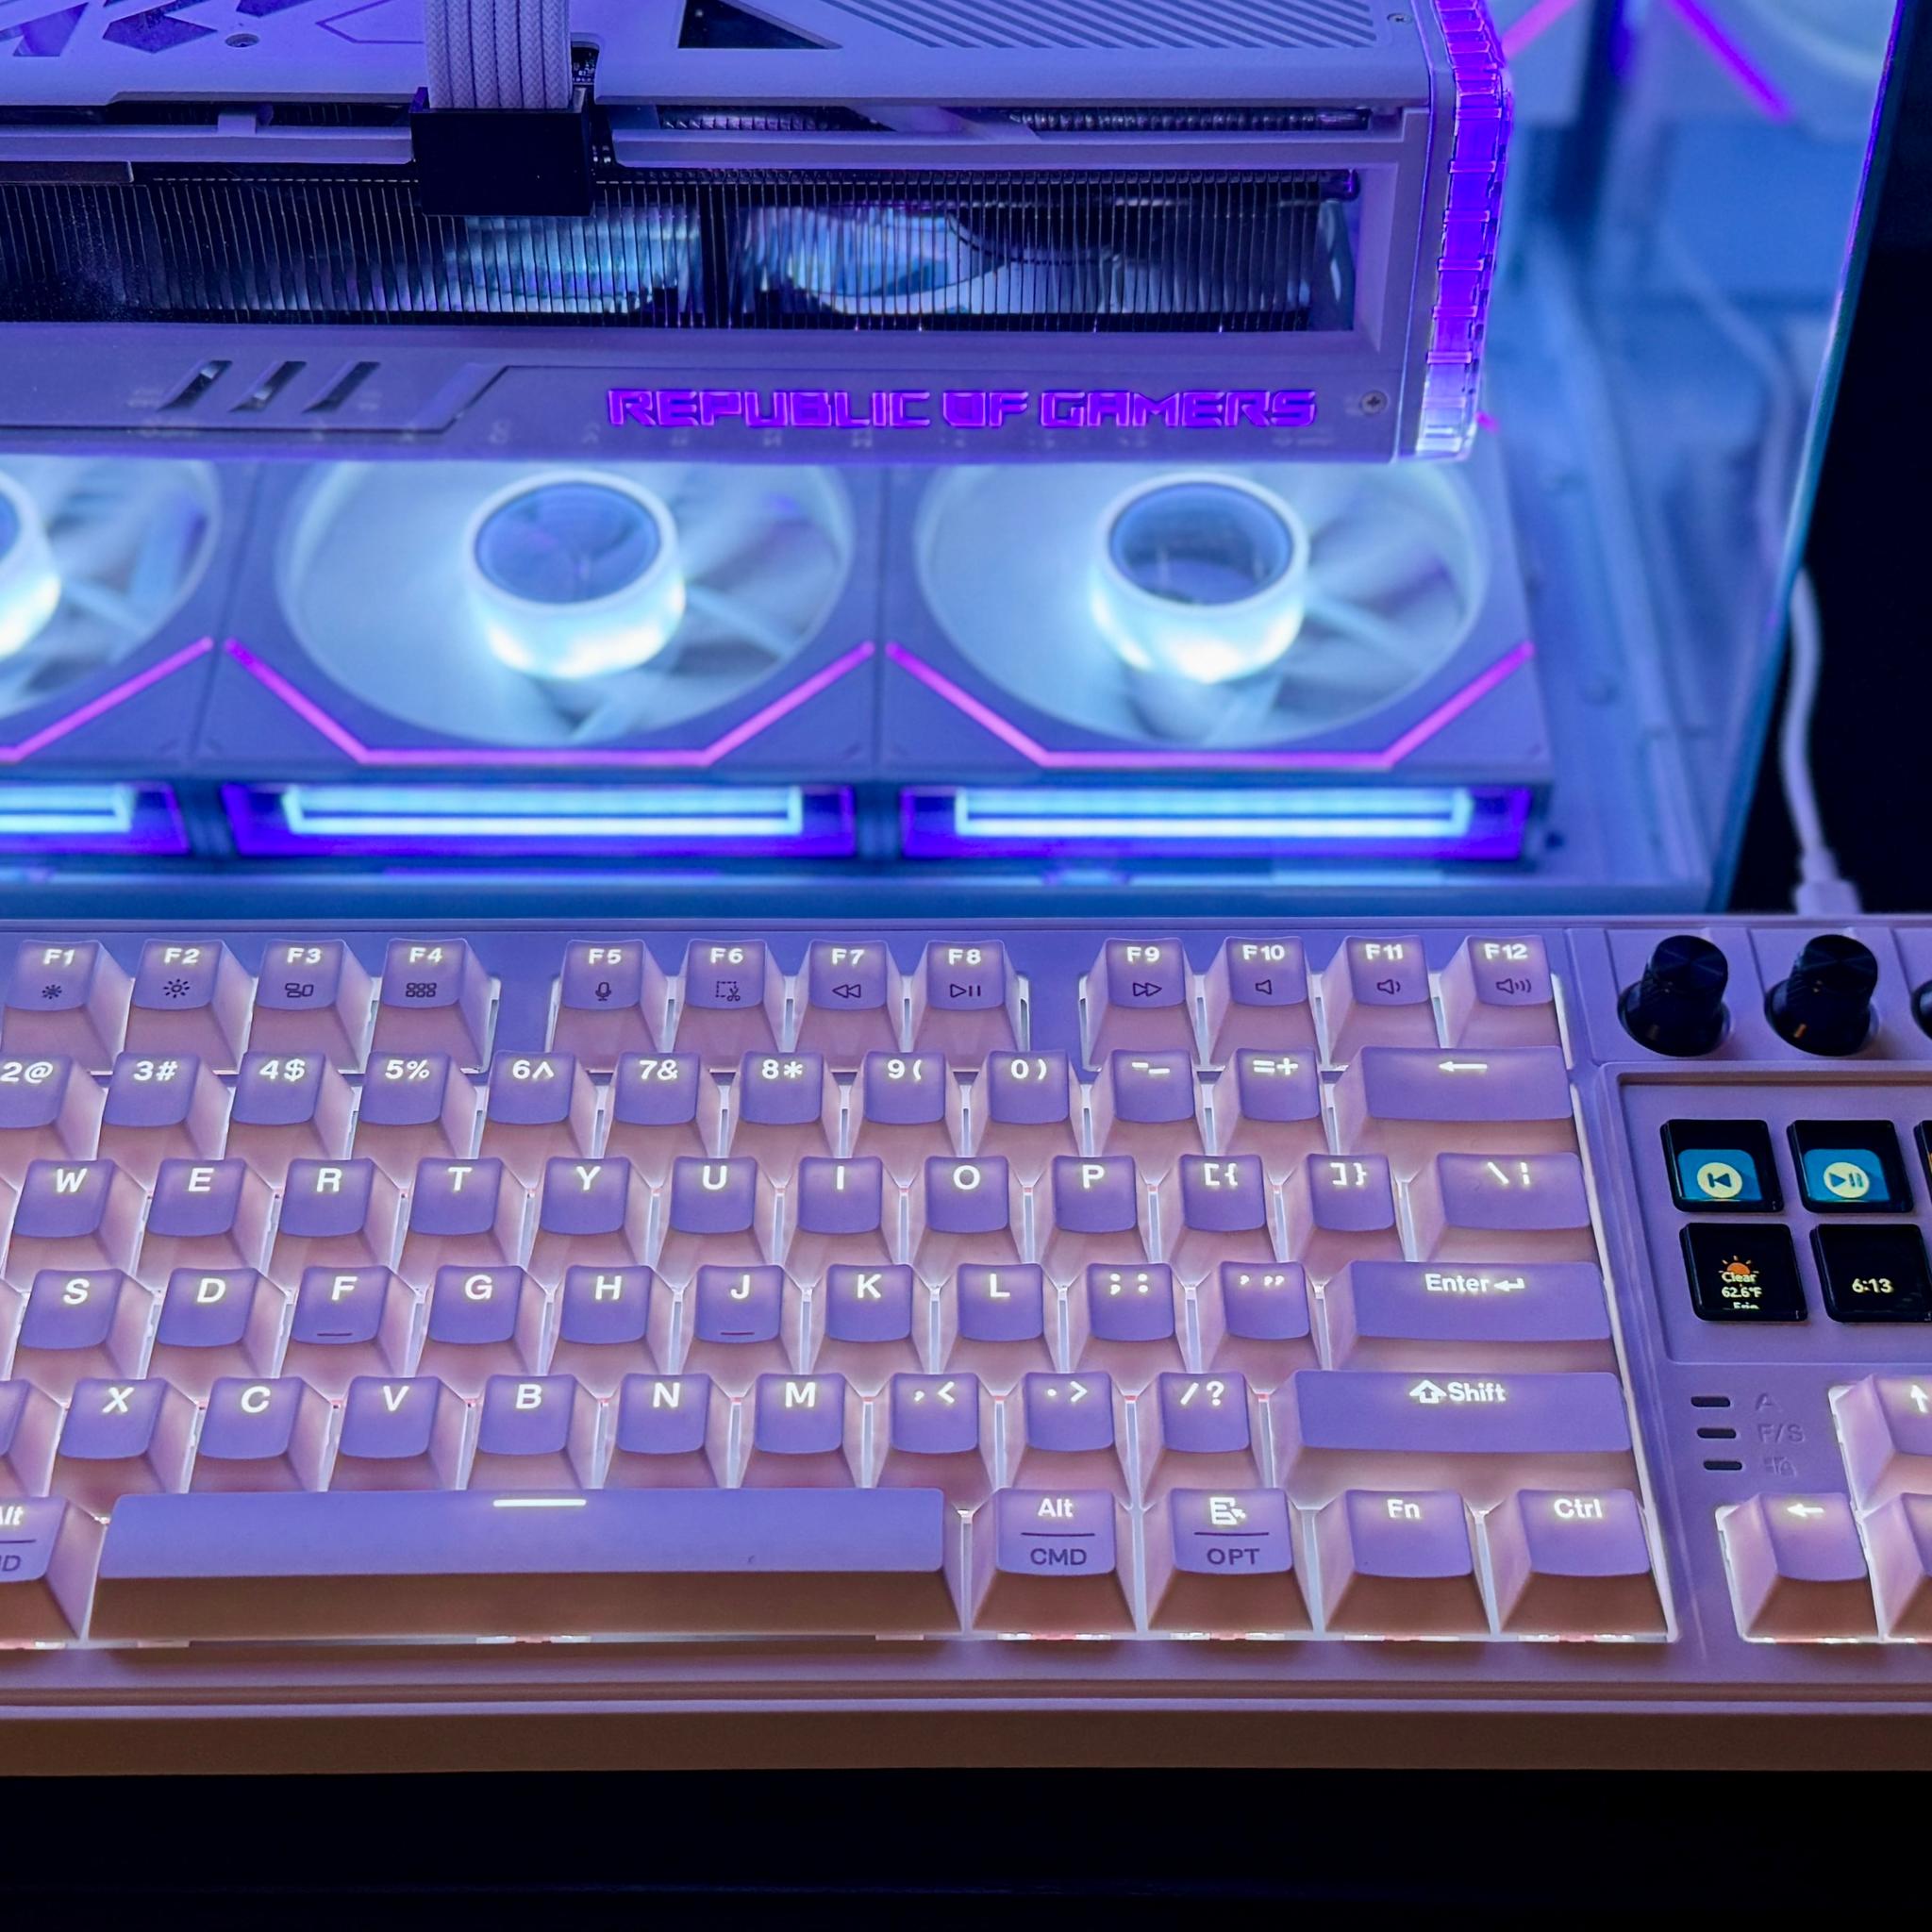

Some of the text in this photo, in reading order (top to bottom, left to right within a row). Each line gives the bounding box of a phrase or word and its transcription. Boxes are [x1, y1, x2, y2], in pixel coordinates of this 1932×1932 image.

[607, 390, 1317, 427] REPUBLIC OF GAMERS
[42, 948, 75, 965] F1
[164, 947, 200, 964] F2
[287, 947, 322, 964] F3
[409, 947, 442, 963] F4
[588, 948, 622, 965] F5
[710, 947, 743, 964] F6
[831, 948, 865, 965] F7
[948, 948, 982, 965] F8
[1126, 946, 1160, 963] F9
[1242, 944, 1286, 961] F10
[1365, 943, 1404, 960] F11
[1484, 942, 1528, 960] F12
[0, 1061, 54, 1084] 2@
[133, 1060, 178, 1081] 3#
[259, 1058, 306, 1082] 4$
[385, 1059, 430, 1080] 5%
[639, 1059, 678, 1081] 7&
[56, 1168, 88, 1193] W
[188, 1167, 214, 1192] E
[316, 1167, 342, 1192] R
[447, 1166, 473, 1191] T
[575, 1166, 601, 1191] Y
[702, 1165, 727, 1191] U
[953, 1165, 981, 1191] O
[1082, 1164, 1106, 1189] P
[331, 1275, 358, 1301] F
[464, 1274, 492, 1300] G
[595, 1275, 623, 1300] H
[730, 1274, 751, 1300] J
[857, 1274, 882, 1299] K
[989, 1273, 1010, 1298] L
[1424, 1274, 1489, 1293] Enter
[1721, 1271, 1757, 1284] Clear
[1851, 1277, 1894, 1294] 6:13
[63, 1278, 91, 1305] S
[196, 1277, 226, 1303] D
[102, 1387, 135, 1413] X
[241, 1386, 271, 1413] C
[383, 1385, 409, 1411] V
[515, 1384, 542, 1409] B
[653, 1382, 681, 1408] N
[785, 1381, 816, 1407] M
[1447, 1381, 1507, 1402] Shift
[1038, 1498, 1074, 1518] Alt
[1387, 1499, 1421, 1519] Fn
[1553, 1498, 1603, 1519] Ctrl
[1029, 1546, 1088, 1567] CMD
[1207, 1547, 1260, 1566] OPT
